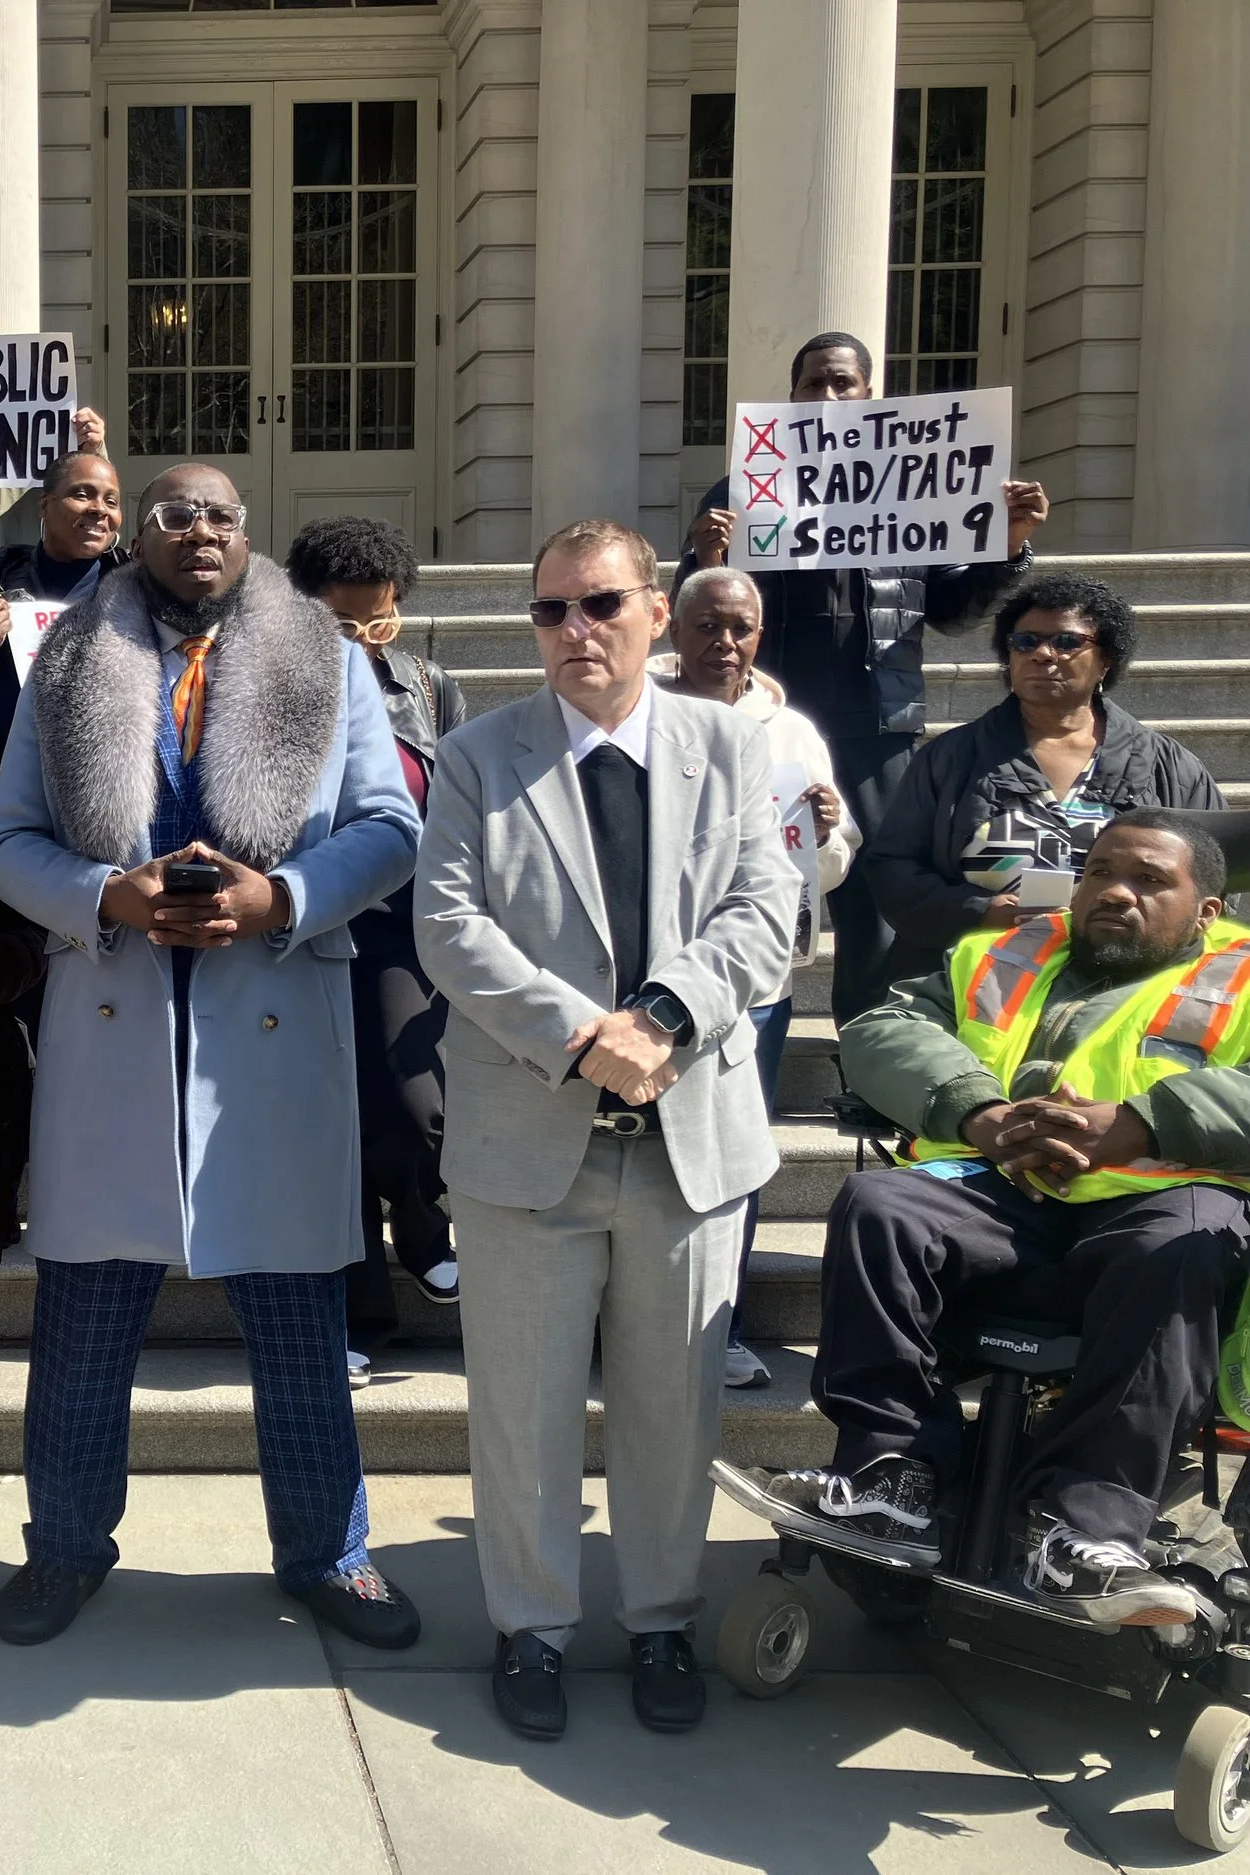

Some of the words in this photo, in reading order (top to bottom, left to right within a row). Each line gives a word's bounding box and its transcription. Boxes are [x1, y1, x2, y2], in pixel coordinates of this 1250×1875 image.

[788, 417, 861, 455] The
[862, 402, 969, 451] Trust
[796, 444, 995, 508] RAD/PACT
[789, 512, 949, 558] Section
[962, 502, 994, 552] 9
[979, 1335, 1039, 1355] permobil
